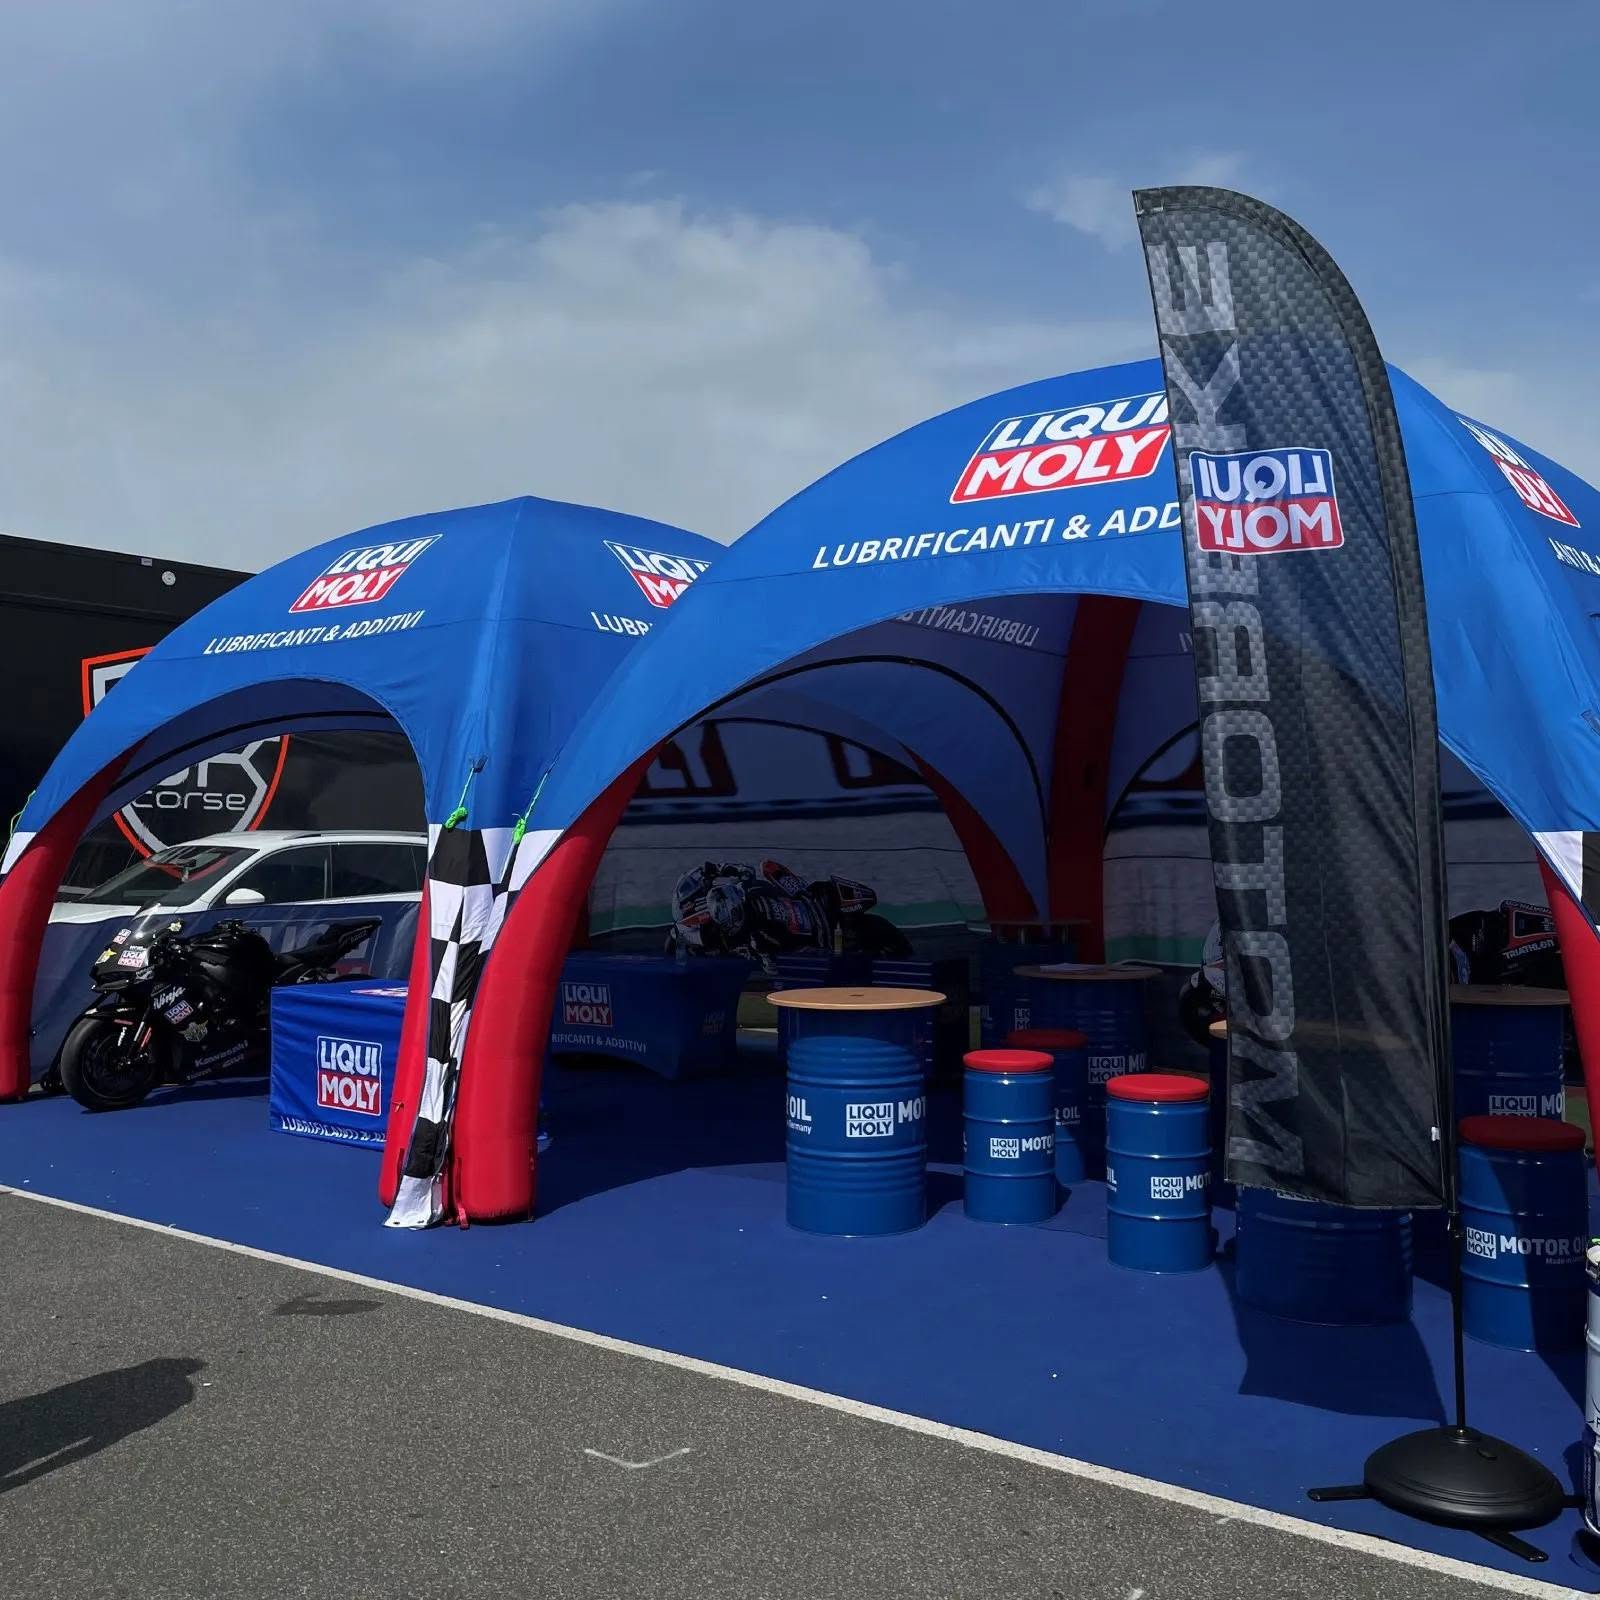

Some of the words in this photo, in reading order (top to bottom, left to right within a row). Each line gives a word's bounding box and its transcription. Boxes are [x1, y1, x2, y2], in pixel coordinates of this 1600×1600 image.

[989, 395, 1169, 451] LIQUI
[964, 428, 1167, 496] MOLY
[1499, 460, 1568, 518] OLY
[812, 518, 1056, 569] LUBRIFICANTI
[1063, 514, 1092, 539] &
[327, 538, 433, 575] LIQUI
[613, 544, 710, 583] LIQU
[297, 567, 405, 608] MOLY
[204, 626, 325, 655] LUBRIFICANTI
[323, 625, 341, 642] &
[340, 610, 425, 640] ADDITIVI
[591, 611, 653, 636] LUBR
[153, 987, 186, 1010] Ninja
[563, 984, 610, 1003] LIQUI
[565, 1004, 612, 1025] MOLY
[604, 1037, 647, 1054] ADDITIVI
[320, 1040, 378, 1076] LIQUI
[1089, 1057, 1123, 1069] LIQUI
[321, 1074, 379, 1111] MOLY
[789, 1096, 812, 1121] OIL
[849, 1105, 892, 1119] LIQUI
[1491, 1097, 1535, 1110] LIQUI
[849, 1121, 892, 1135] MOLY
[991, 1140, 1018, 1148] LIQUI
[991, 1148, 1018, 1157] MOLY
[1152, 1179, 1183, 1187] LIQUI
[1152, 1189, 1183, 1198] MOLY
[1467, 1228, 1494, 1244] LIQUI
[1500, 1235, 1570, 1256] MOTOR
[1467, 1242, 1495, 1258] MOLY
